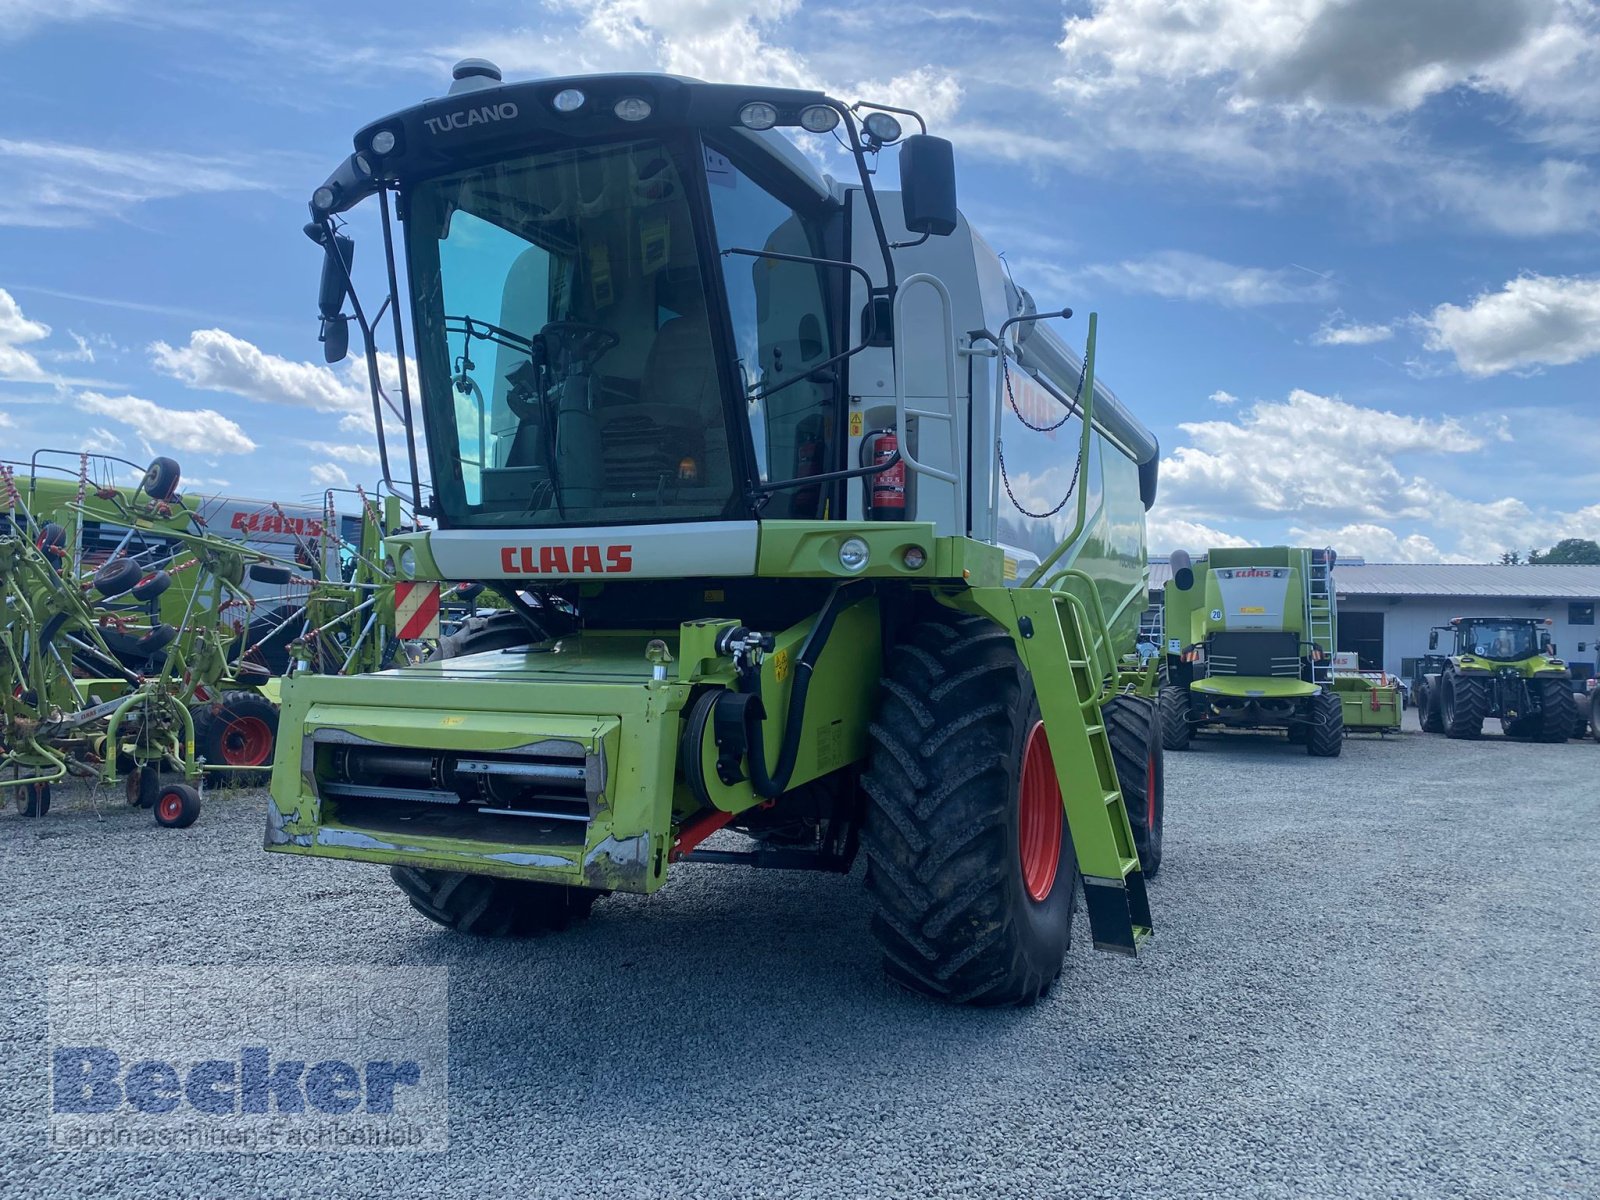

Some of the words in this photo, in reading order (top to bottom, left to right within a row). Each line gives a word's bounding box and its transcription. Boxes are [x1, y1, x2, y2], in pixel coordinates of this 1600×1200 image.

[423, 102, 519, 135] TUCANO
[231, 512, 323, 537] CLAAS
[500, 545, 632, 574] CLAAS
[1235, 569, 1272, 578] CLAAS
[1212, 610, 1221, 619] 20
